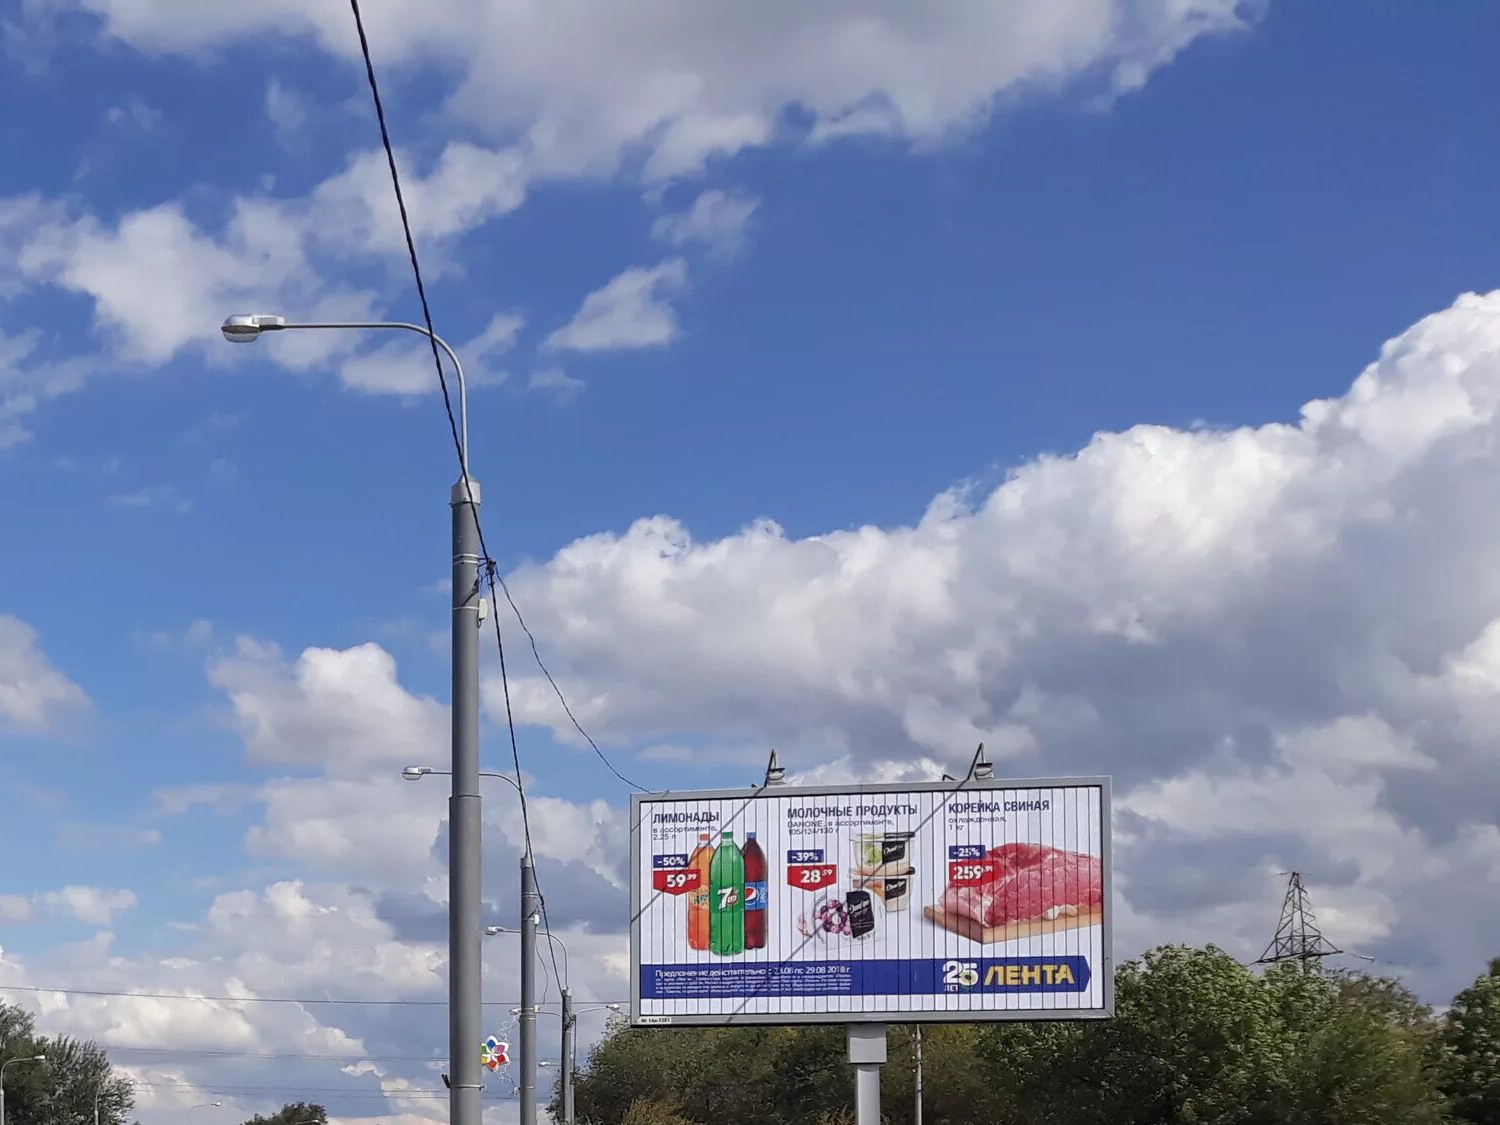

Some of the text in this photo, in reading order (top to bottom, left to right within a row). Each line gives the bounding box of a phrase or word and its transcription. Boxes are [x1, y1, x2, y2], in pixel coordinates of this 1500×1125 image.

[788, 804, 918, 818] МОЛОЧНЫЕ ПРОДУКТЫ
[948, 800, 1050, 813] КОРЕЙКА СВИНАЯ
[653, 812, 720, 824] ЛИМОНАДЫ
[657, 857, 685, 866] -50%
[792, 852, 818, 861] -39%
[943, 961, 978, 986] 25
[984, 964, 1075, 986] ЛЕНТА
